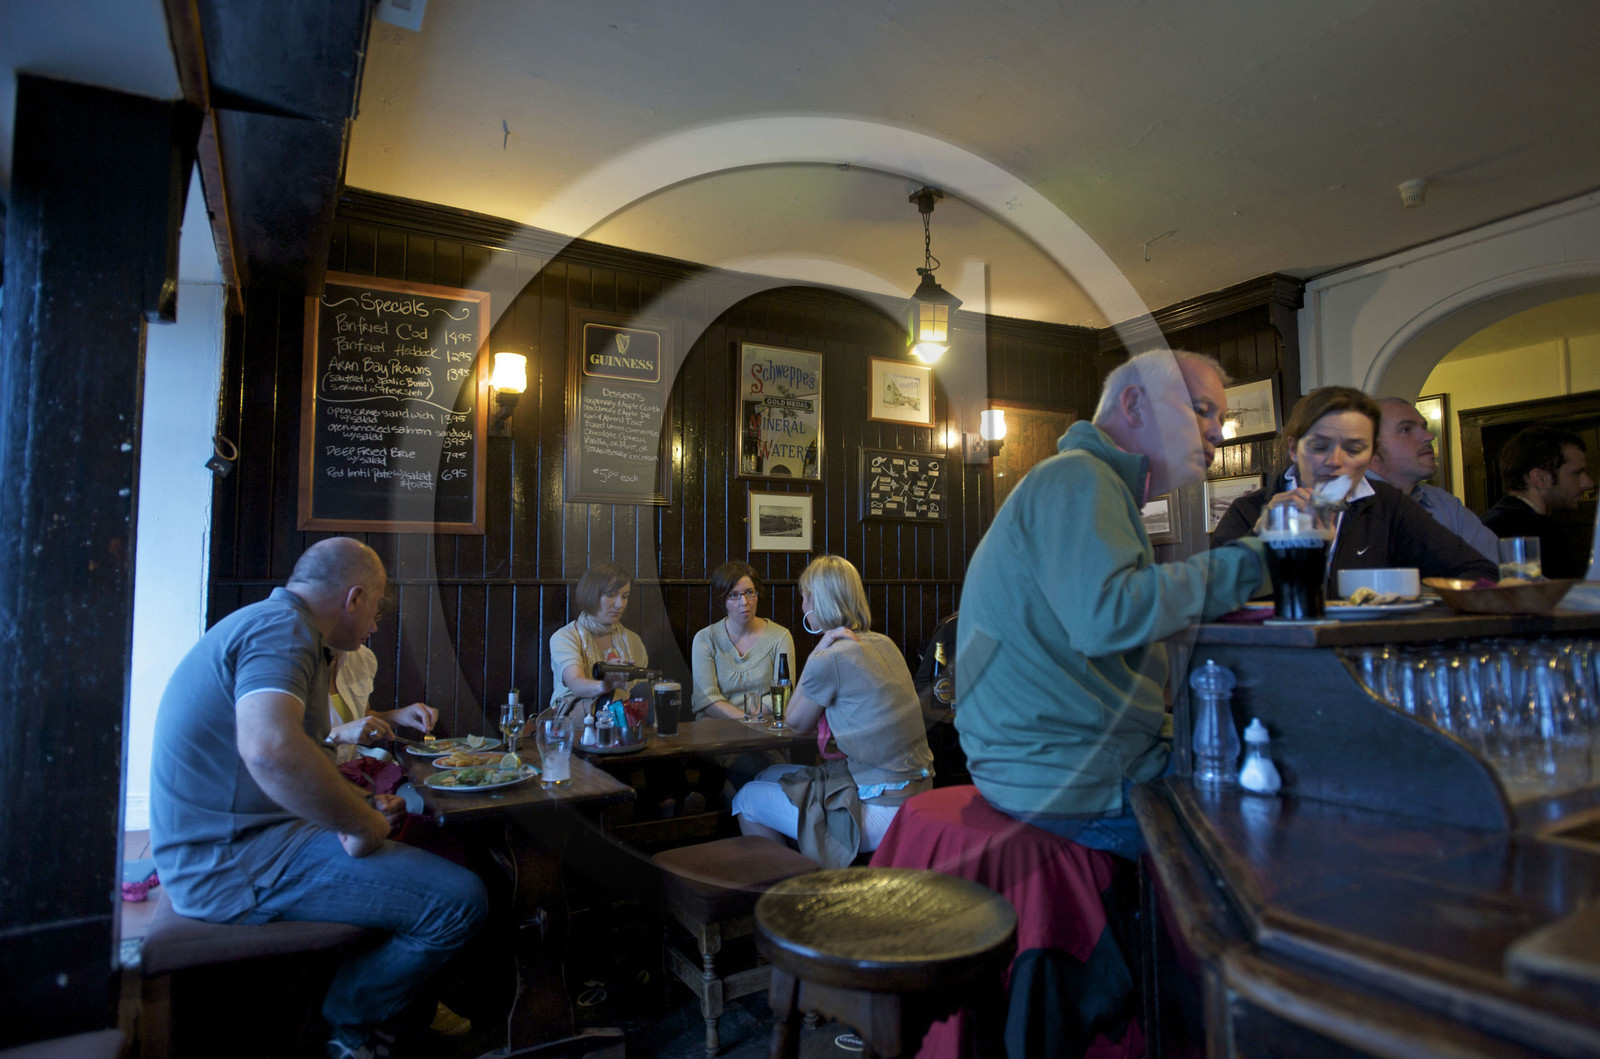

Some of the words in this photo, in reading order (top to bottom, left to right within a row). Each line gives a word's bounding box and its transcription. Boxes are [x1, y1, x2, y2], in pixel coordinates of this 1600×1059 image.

[360, 293, 429, 317] Specials
[335, 313, 388, 335] Panfried
[396, 323, 428, 340] Cod
[332, 336, 385, 354] Panfried
[362, 356, 389, 380] Bay
[388, 358, 432, 377] Prawns
[590, 354, 654, 371] GUINNESS
[375, 377, 406, 389] garlic
[750, 359, 815, 395] Schweppes
[330, 384, 367, 393] served
[621, 401, 639, 410] Apple
[766, 398, 785, 406] GOLD
[786, 399, 809, 409] MEDAL
[381, 409, 436, 421] sandwich
[350, 423, 390, 434] smoked
[391, 425, 432, 437] salmon
[435, 428, 473, 440] sandwich
[583, 428, 617, 439] Chocolate
[749, 414, 806, 438] MINERAL
[758, 440, 812, 462] WATERS
[326, 466, 344, 478] Red
[620, 473, 639, 482] each
